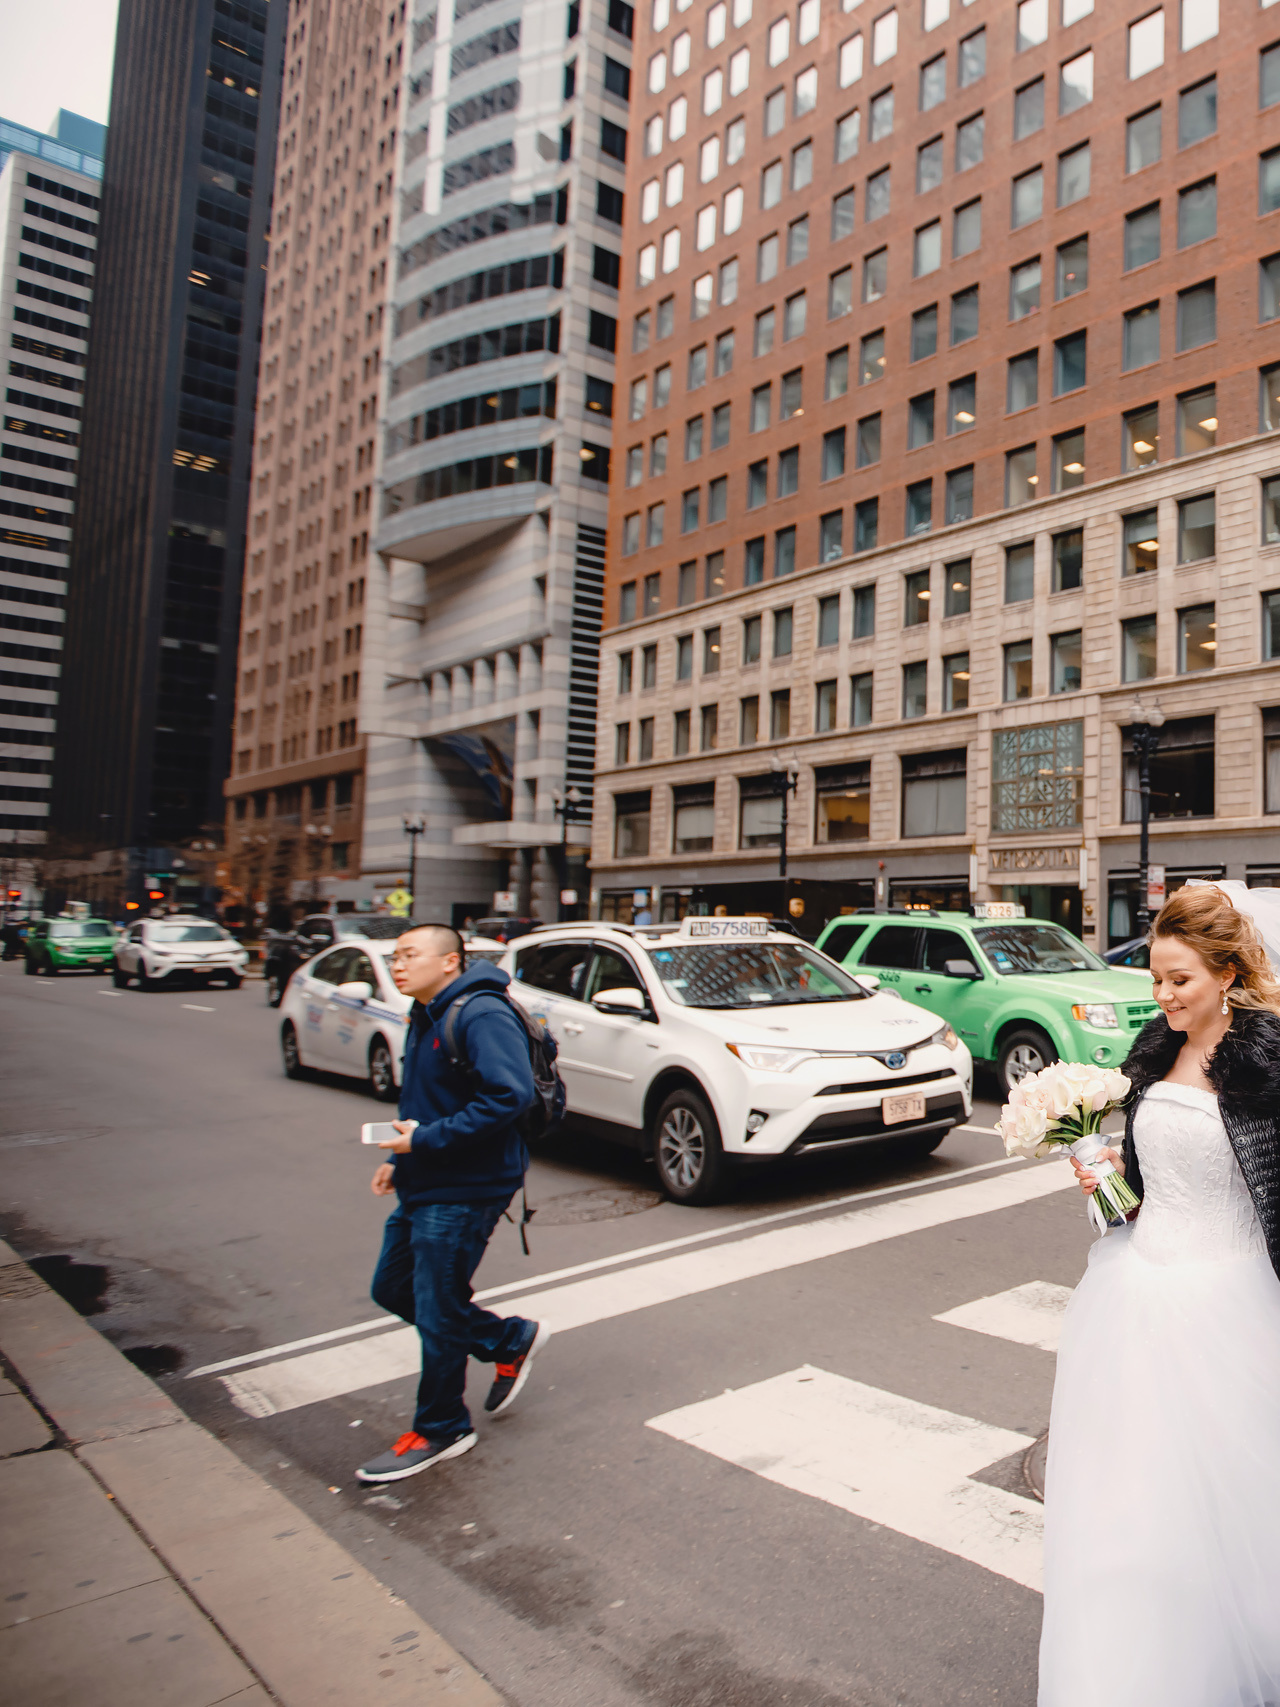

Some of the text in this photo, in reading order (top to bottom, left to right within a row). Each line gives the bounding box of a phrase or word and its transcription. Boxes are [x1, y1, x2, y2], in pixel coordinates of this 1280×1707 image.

[991, 847, 1080, 869] METROPOLITAN
[987, 905, 1013, 917] 6326
[711, 921, 749, 936] 5758
